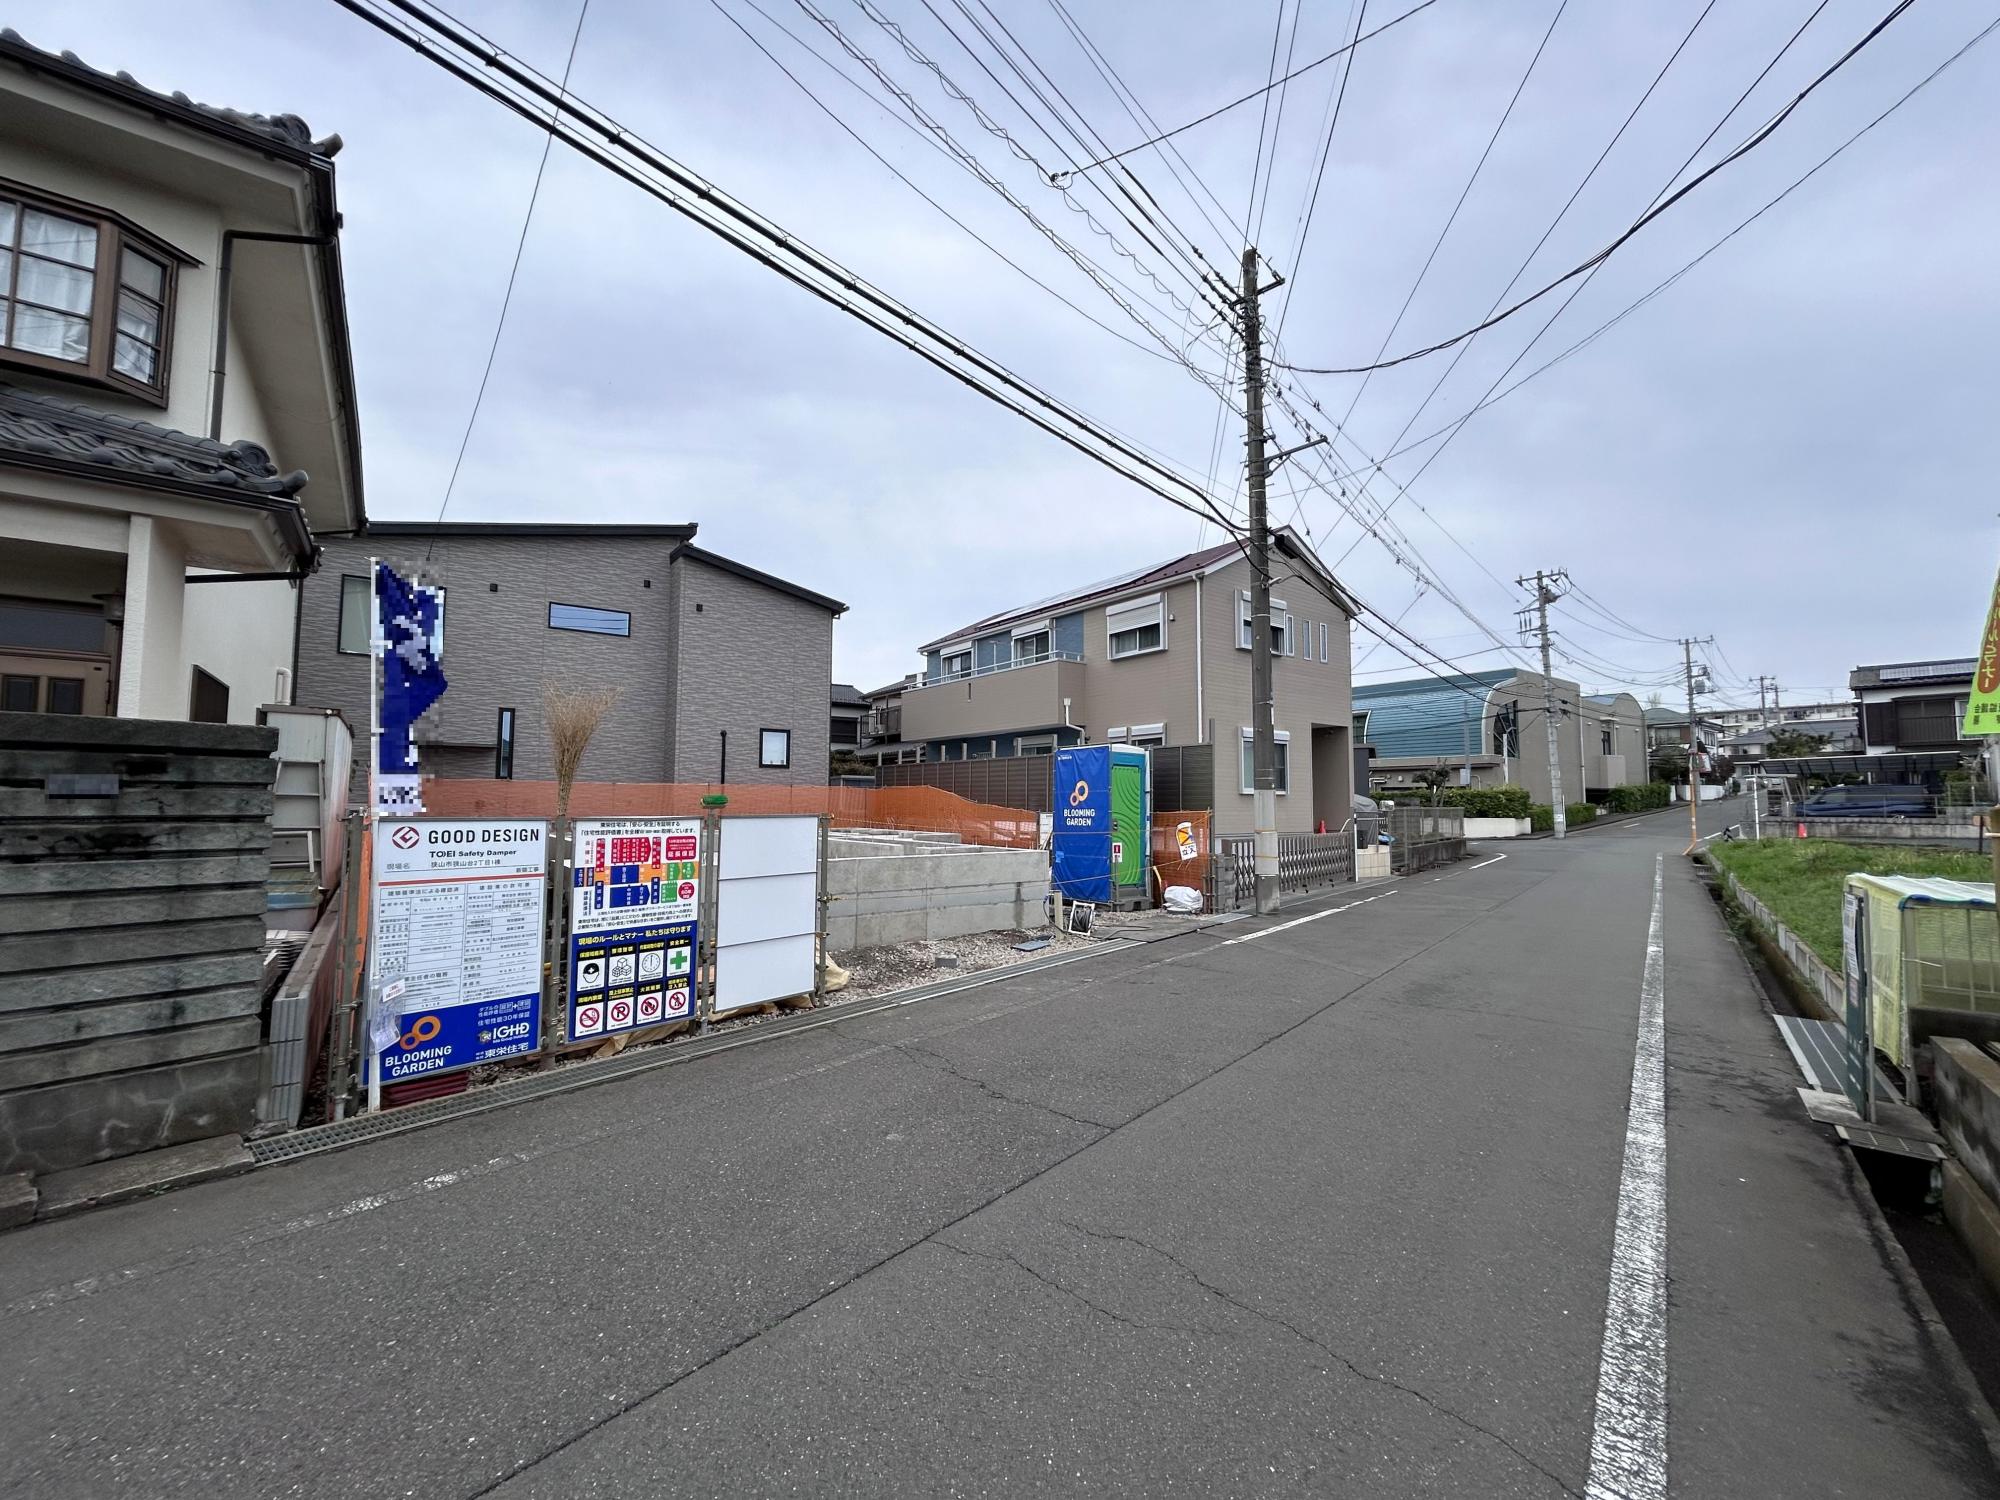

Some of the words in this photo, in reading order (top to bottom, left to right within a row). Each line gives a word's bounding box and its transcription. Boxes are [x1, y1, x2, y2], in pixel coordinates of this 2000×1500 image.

[1064, 808, 1095, 817] BLOOMING
[1066, 817, 1091, 826] GARDEN
[428, 830, 475, 844] GOOD
[482, 828, 539, 843] DESIGN
[578, 932, 644, 945] 現場のルールとマナー
[646, 926, 692, 937] 私たちは守ります
[385, 1045, 452, 1067] BLOOMING
[484, 1042, 528, 1058] 東栄住宅
[392, 1058, 444, 1077] GARDEN
